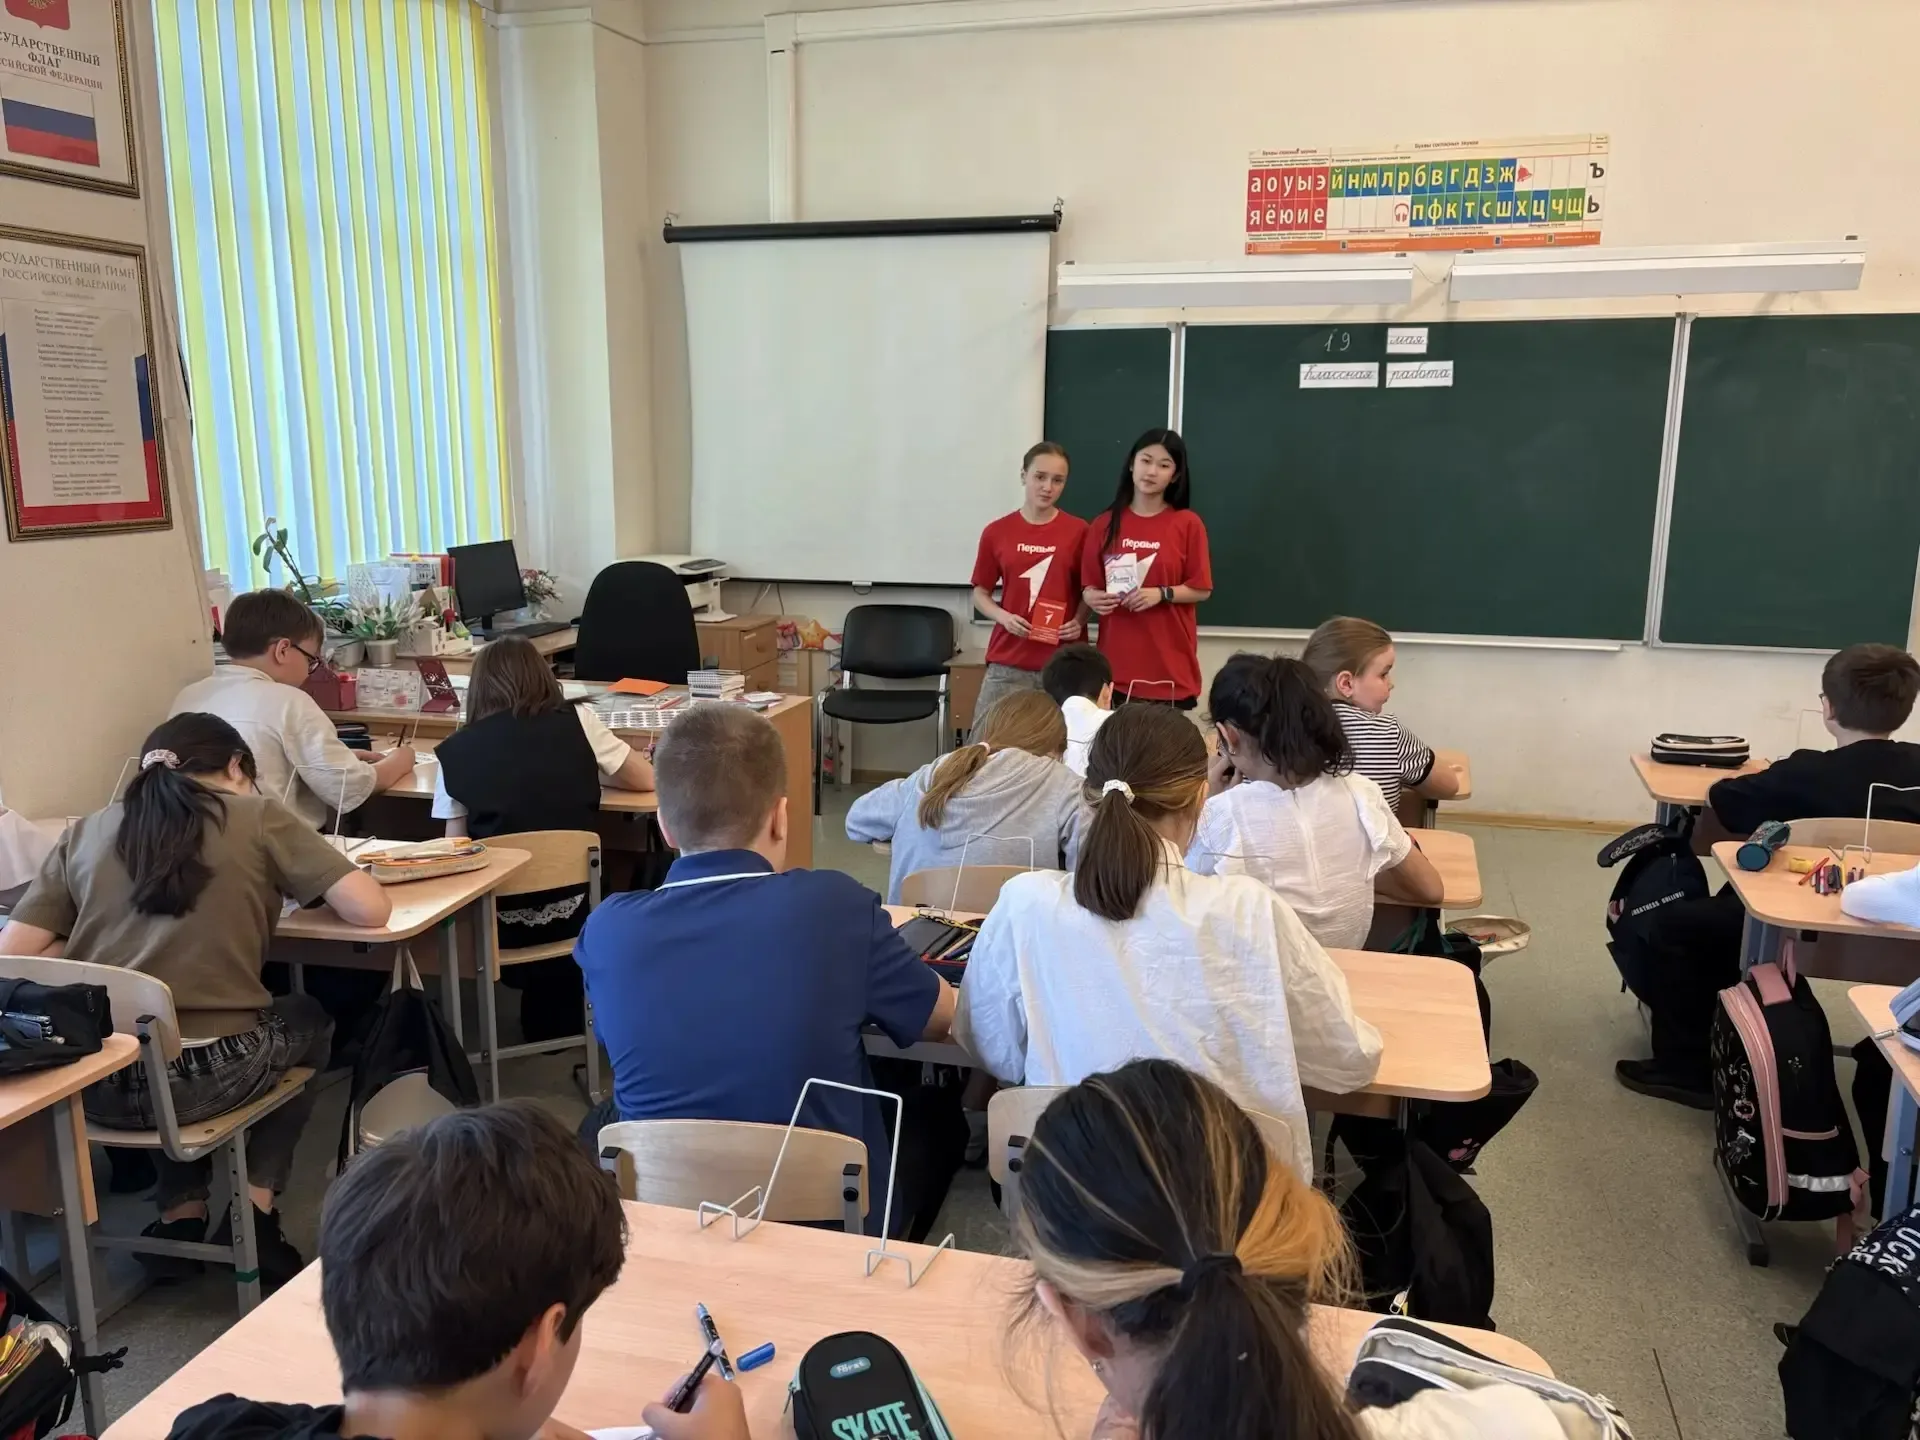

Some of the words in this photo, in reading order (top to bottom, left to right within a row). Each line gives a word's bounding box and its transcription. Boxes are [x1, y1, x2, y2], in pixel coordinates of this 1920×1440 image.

[0, 31, 101, 66] УДАРСТВЕННЫЙ
[28, 51, 62, 68] ФЛАГ
[0, 57, 47, 76] СИЙСКОЙ
[50, 71, 103, 90] ФЕДЕРАЦИИ
[1331, 168, 1342, 189] й
[2, 267, 72, 286] РОССИЙСКОЙ
[75, 278, 127, 292] ФЕДЕРАЦИИ
[105, 265, 136, 280] ГИМН
[1324, 329, 1350, 352] 19
[1390, 335, 1424, 345] мая
[1303, 364, 1373, 381] Классная
[1388, 362, 1451, 386] работа
[1017, 543, 1057, 554] Первые
[1121, 538, 1161, 550] Первые
[831, 1400, 921, 1440] SKATE
